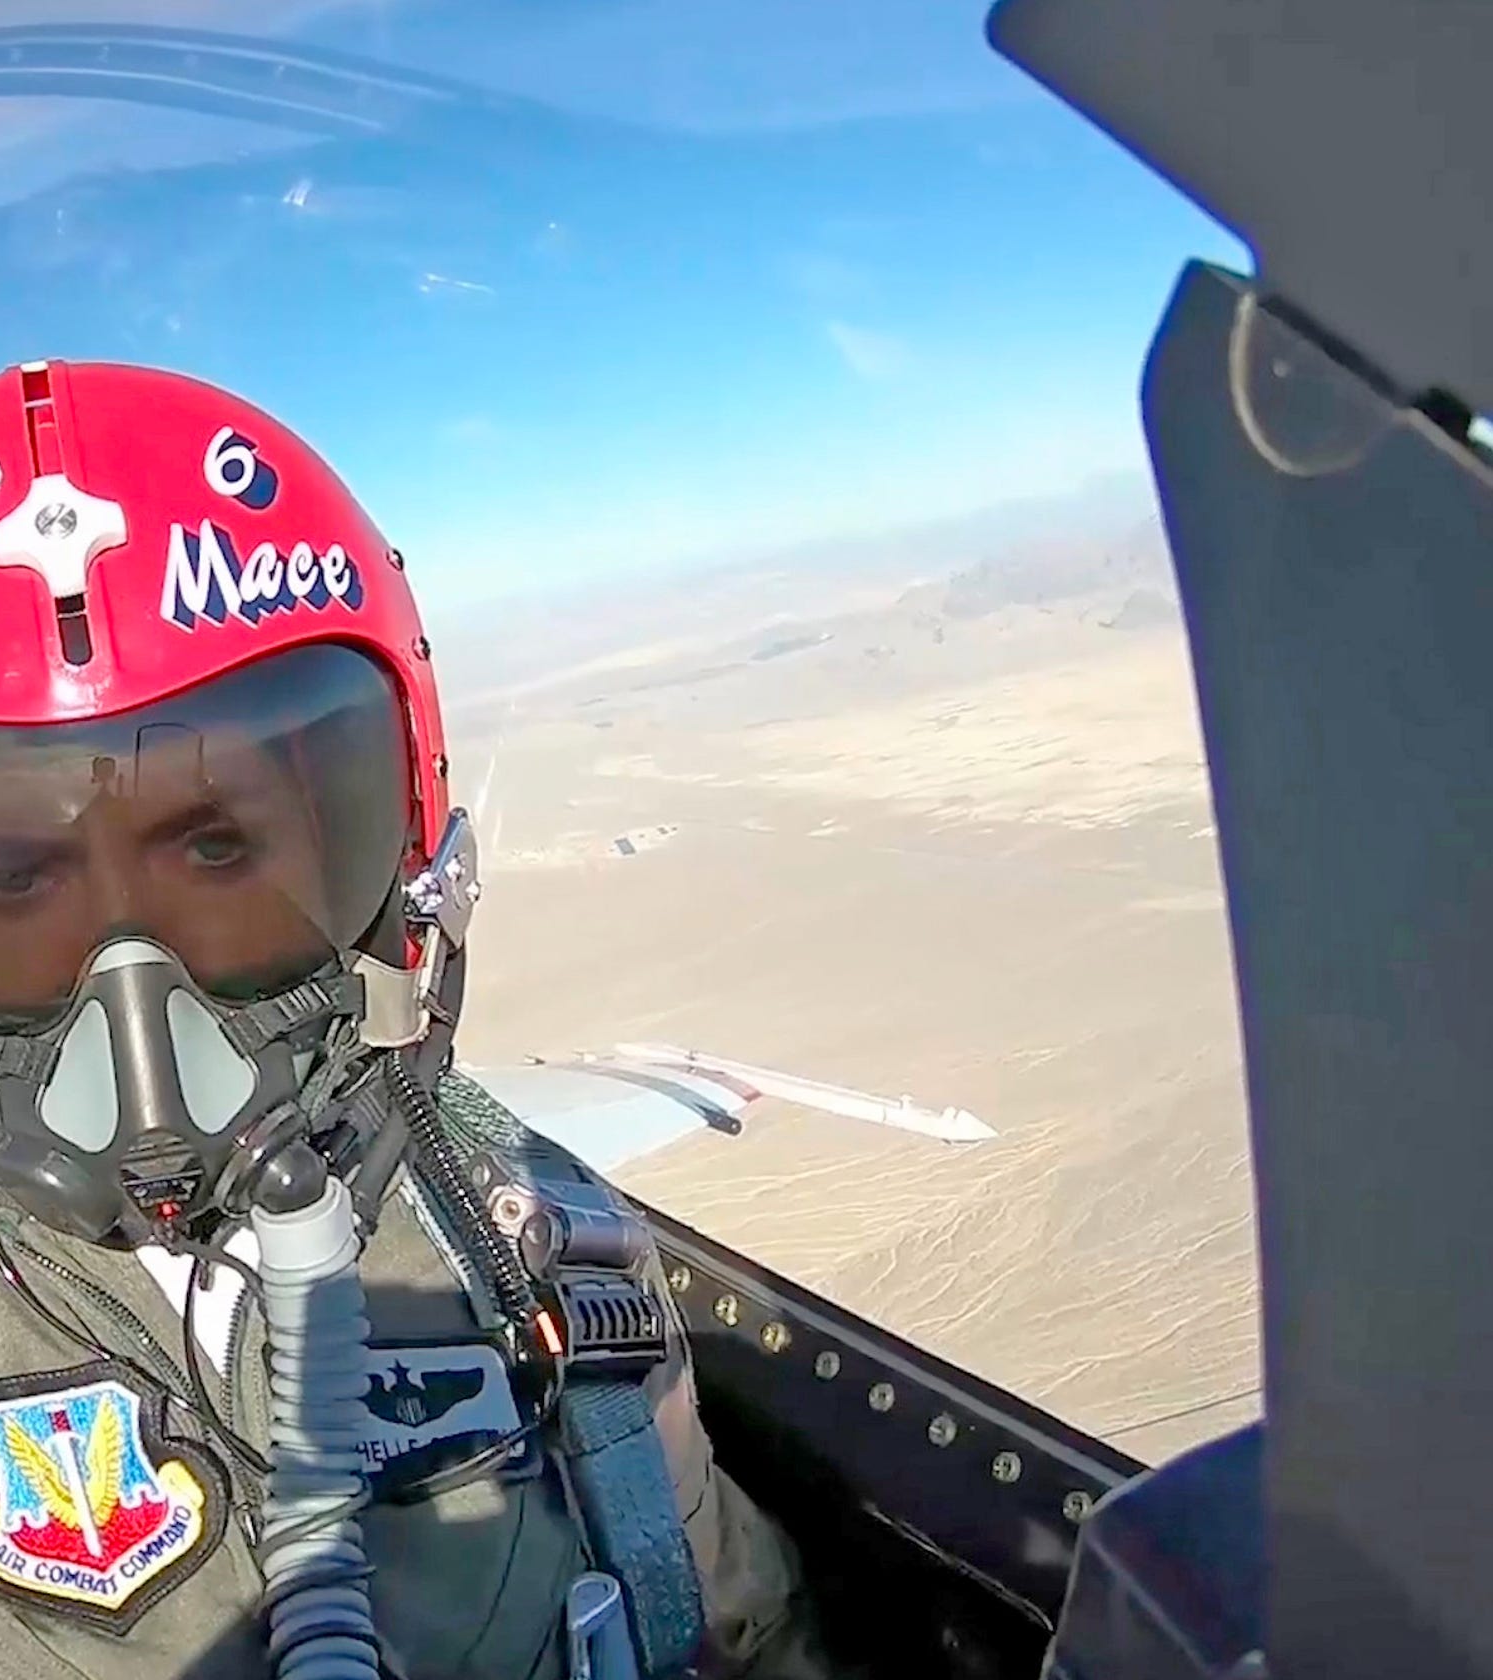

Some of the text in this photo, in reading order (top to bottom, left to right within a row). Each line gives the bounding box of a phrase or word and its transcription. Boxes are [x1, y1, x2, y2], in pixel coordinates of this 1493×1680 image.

[204, 425, 278, 510] 6
[162, 518, 364, 633] Mace
[34, 1564, 119, 1595] COMBAT
[119, 1504, 191, 1578] COMMAND
